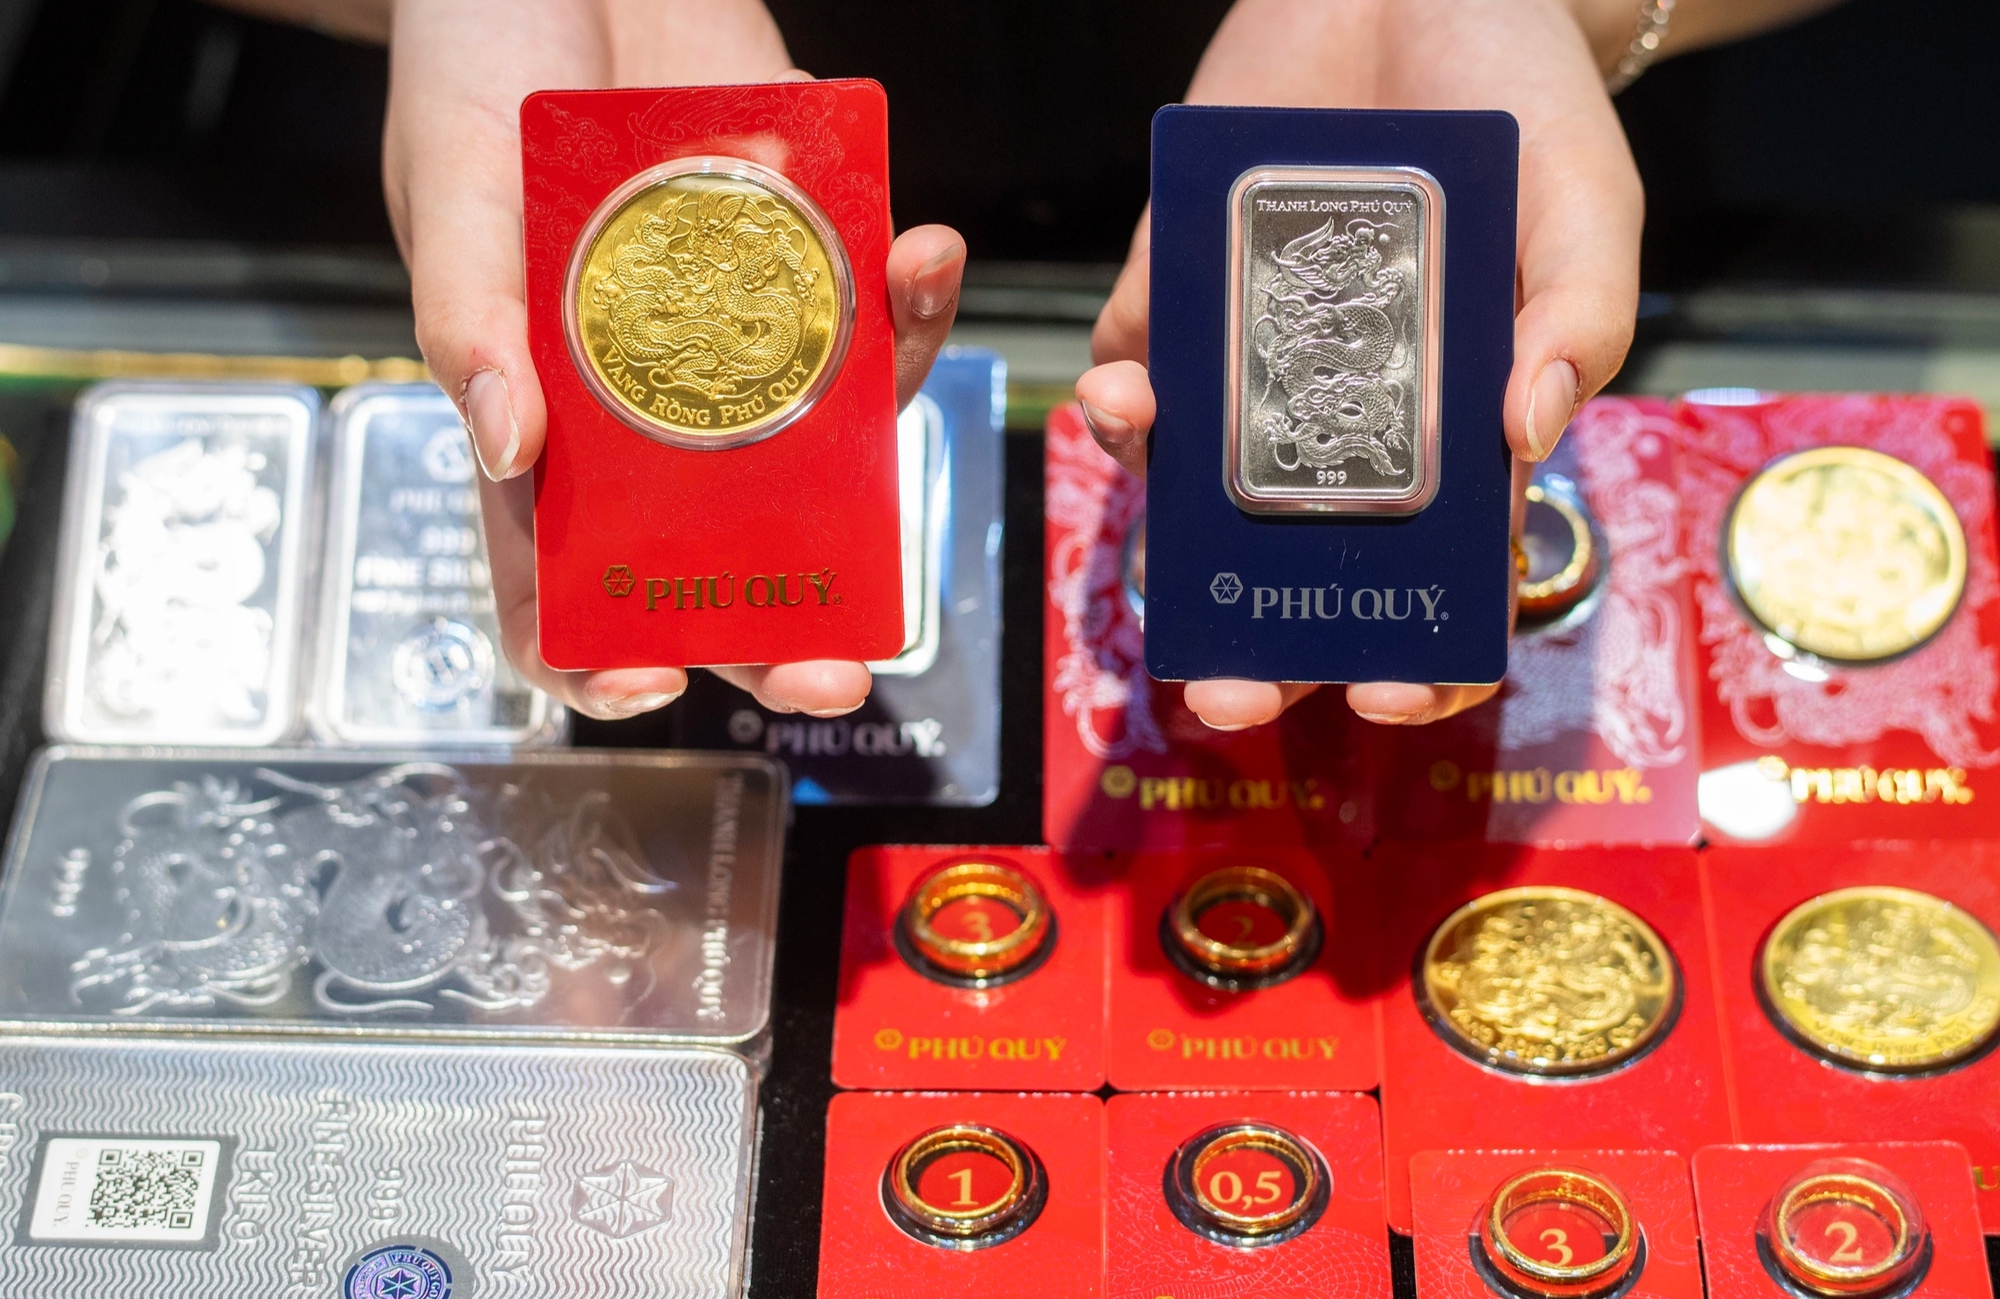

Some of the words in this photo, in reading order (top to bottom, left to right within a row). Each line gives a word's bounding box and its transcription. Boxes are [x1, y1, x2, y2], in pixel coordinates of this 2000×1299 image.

[1257, 199, 1308, 212] THANH
[1310, 199, 1348, 213] LONG
[1350, 199, 1380, 213] PHÚ
[601, 345, 648, 403] VÀNG
[719, 395, 767, 425] PHÚ
[767, 359, 810, 402] QUÝ
[1316, 470, 1347, 486] 999
[645, 571, 735, 611] PHÚ
[1251, 583, 1343, 620] PHÚ
[963, 911, 992, 943] 3
[1229, 915, 1257, 949] 2
[311, 1101, 350, 1168] FINE
[368, 1167, 404, 1222] 999
[948, 1168, 979, 1206] 1
[1209, 1170, 1282, 1210] 0,5
[290, 1178, 336, 1290] SILVER
[1539, 1228, 1574, 1267] 3
[1824, 1221, 1864, 1263] 2
